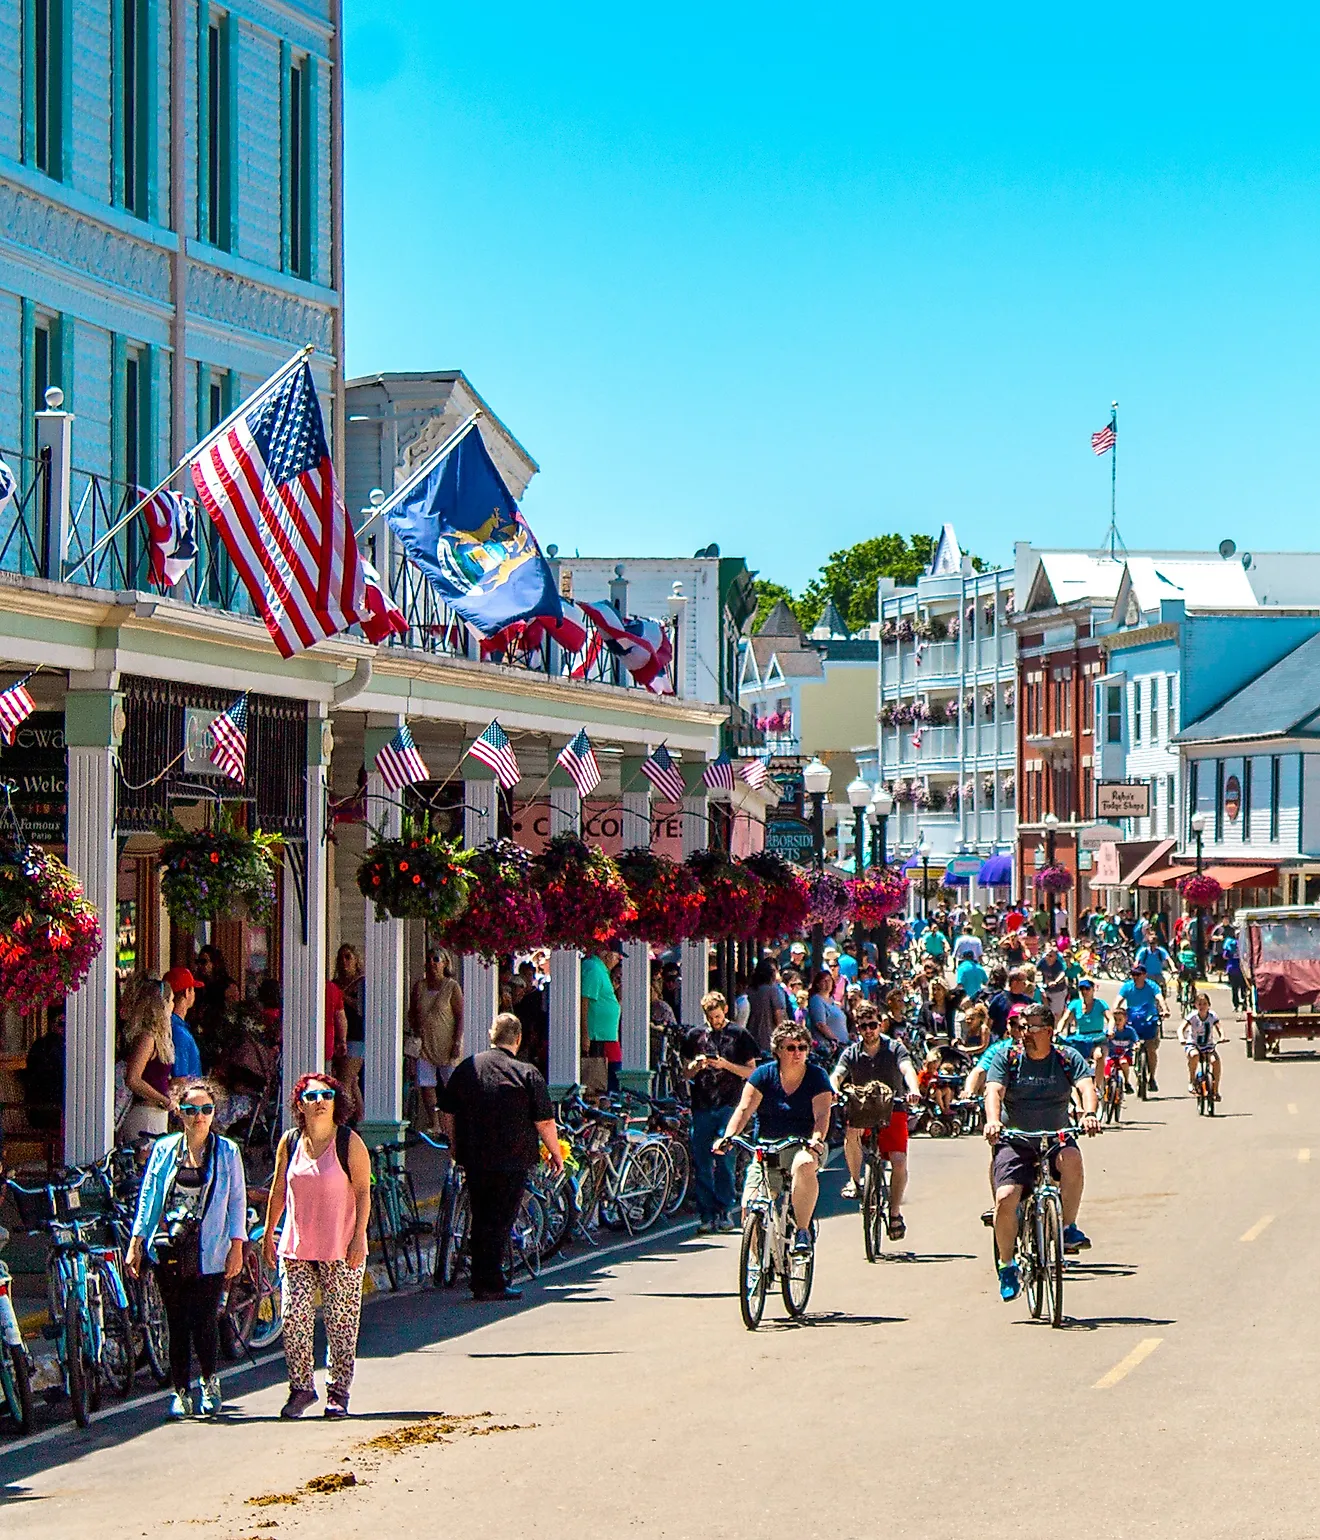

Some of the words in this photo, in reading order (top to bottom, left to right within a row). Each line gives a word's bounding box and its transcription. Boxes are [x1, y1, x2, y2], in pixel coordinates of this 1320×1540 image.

[16, 728, 65, 748] ewa
[23, 775, 68, 793] Welc
[766, 834, 814, 848] RBORSID
